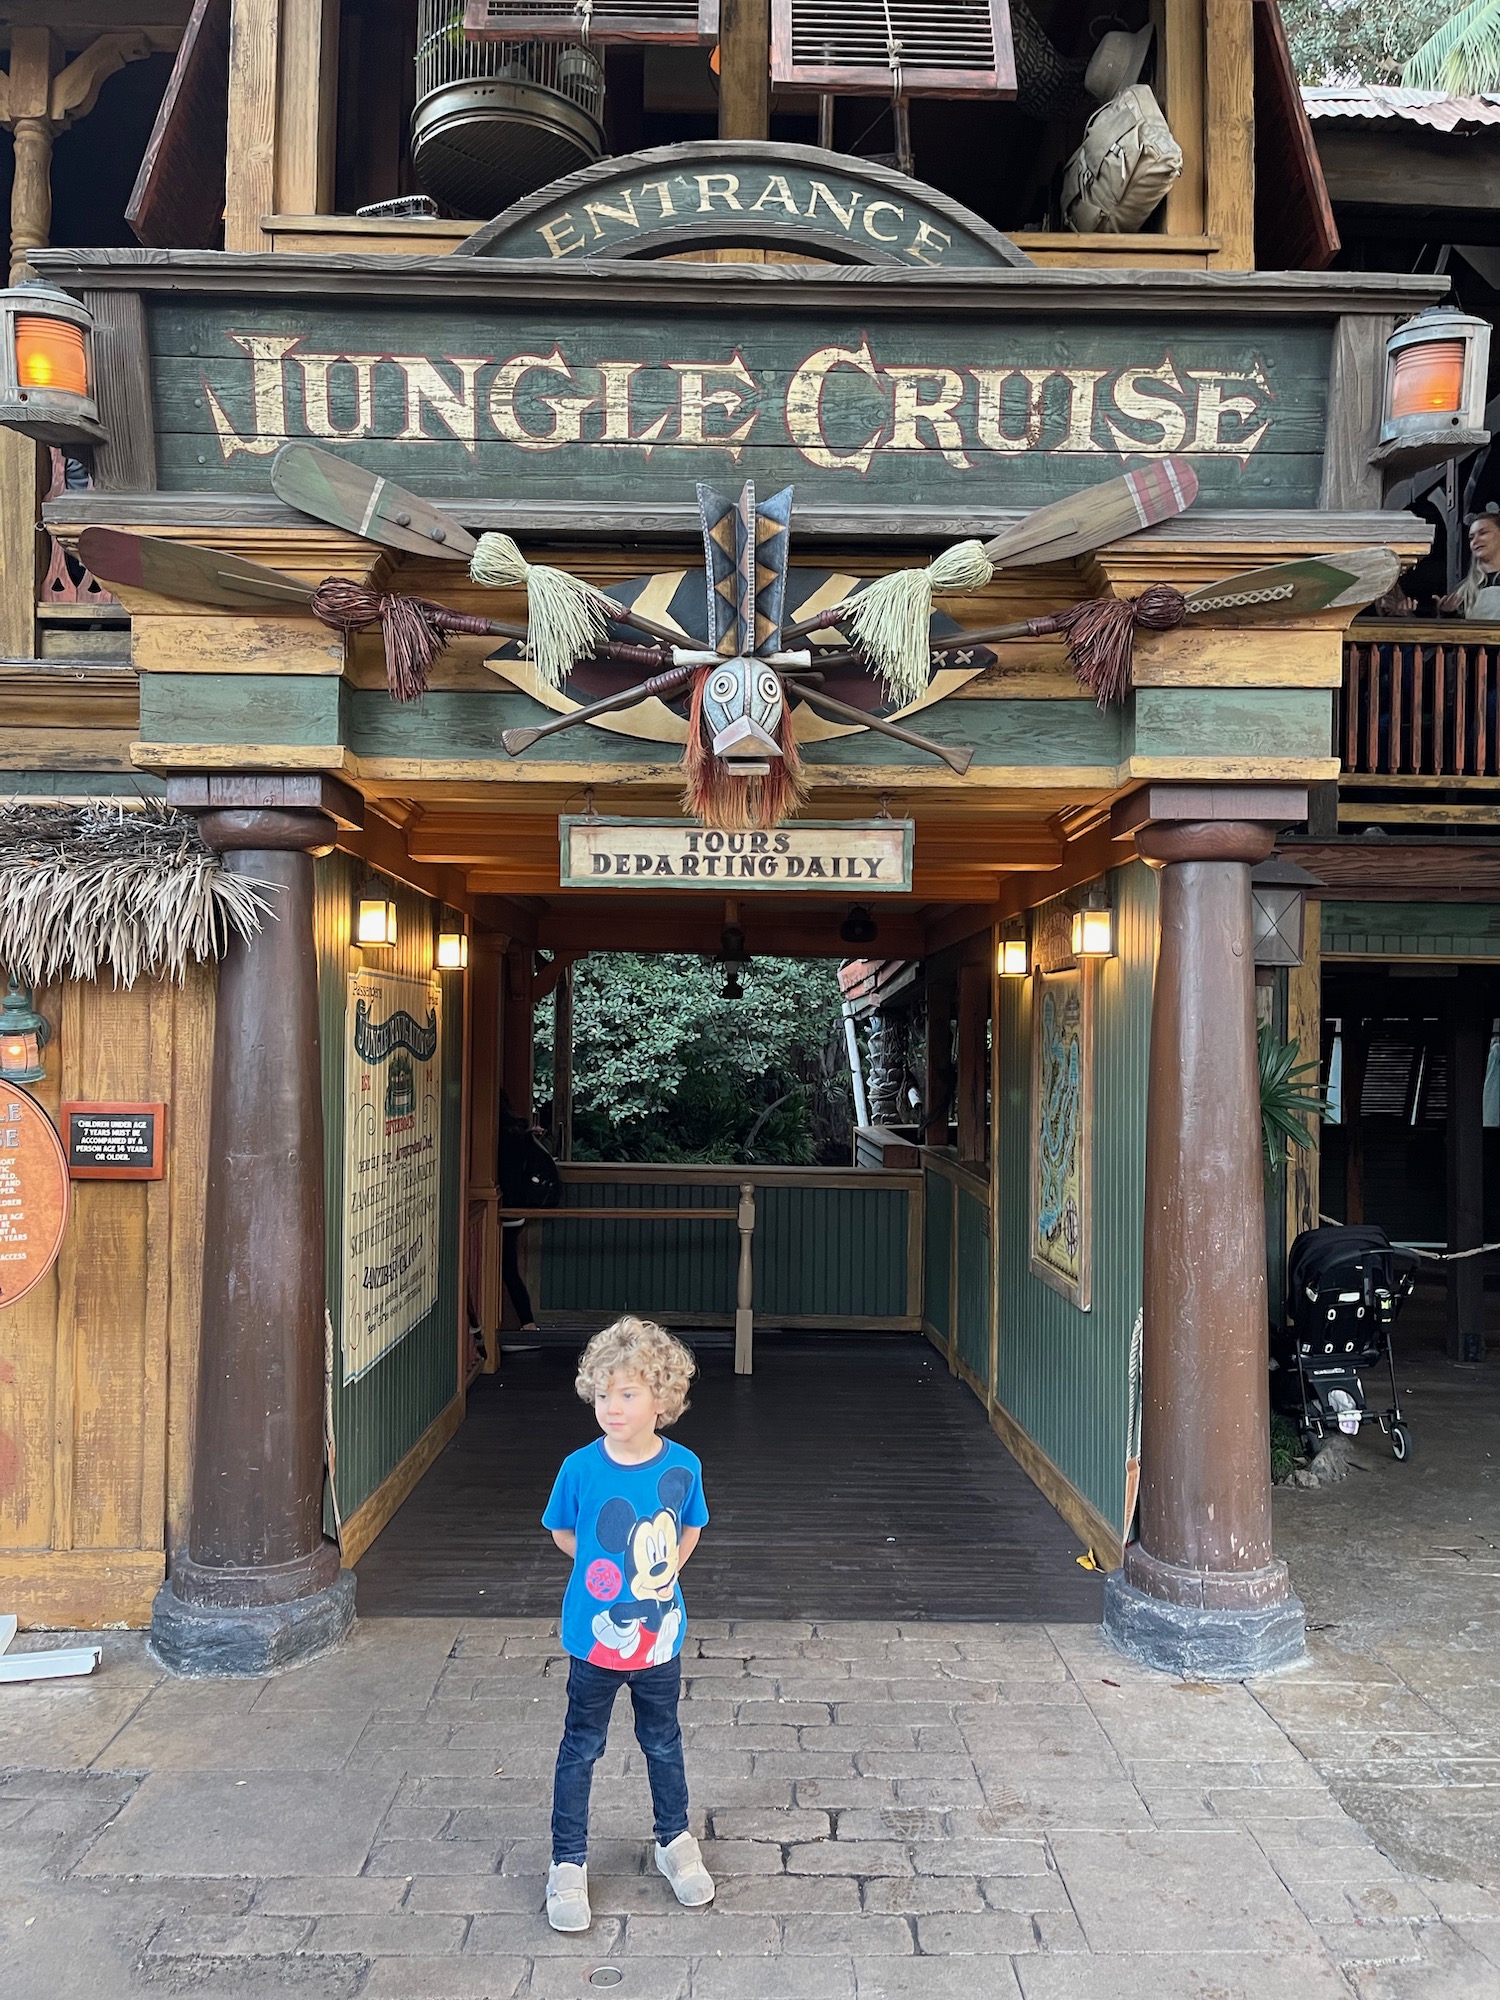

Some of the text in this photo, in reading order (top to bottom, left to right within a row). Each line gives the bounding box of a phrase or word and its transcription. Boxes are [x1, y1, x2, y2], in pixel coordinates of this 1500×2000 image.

[536, 172, 952, 266] ENTRANCE
[203, 332, 1275, 477] JUNGLE CRUISE
[685, 831, 791, 853] TOURS
[590, 853, 885, 879] DEPARTING DAILY
[0, 1103, 22, 1122] E
[78, 1120, 110, 1128] CHILDREN
[133, 1121, 147, 1129] AGE
[83, 1128, 89, 1136] 7
[132, 1129, 141, 1137] BE
[81, 1137, 144, 1145] ACCOMPANIED BY A
[76, 1145, 103, 1153] PERSON
[103, 1145, 116, 1153] AGE
[117, 1145, 126, 1153] 14
[95, 1153, 131, 1161] OR OLDER.
[4, 1233, 28, 1241] YEARS
